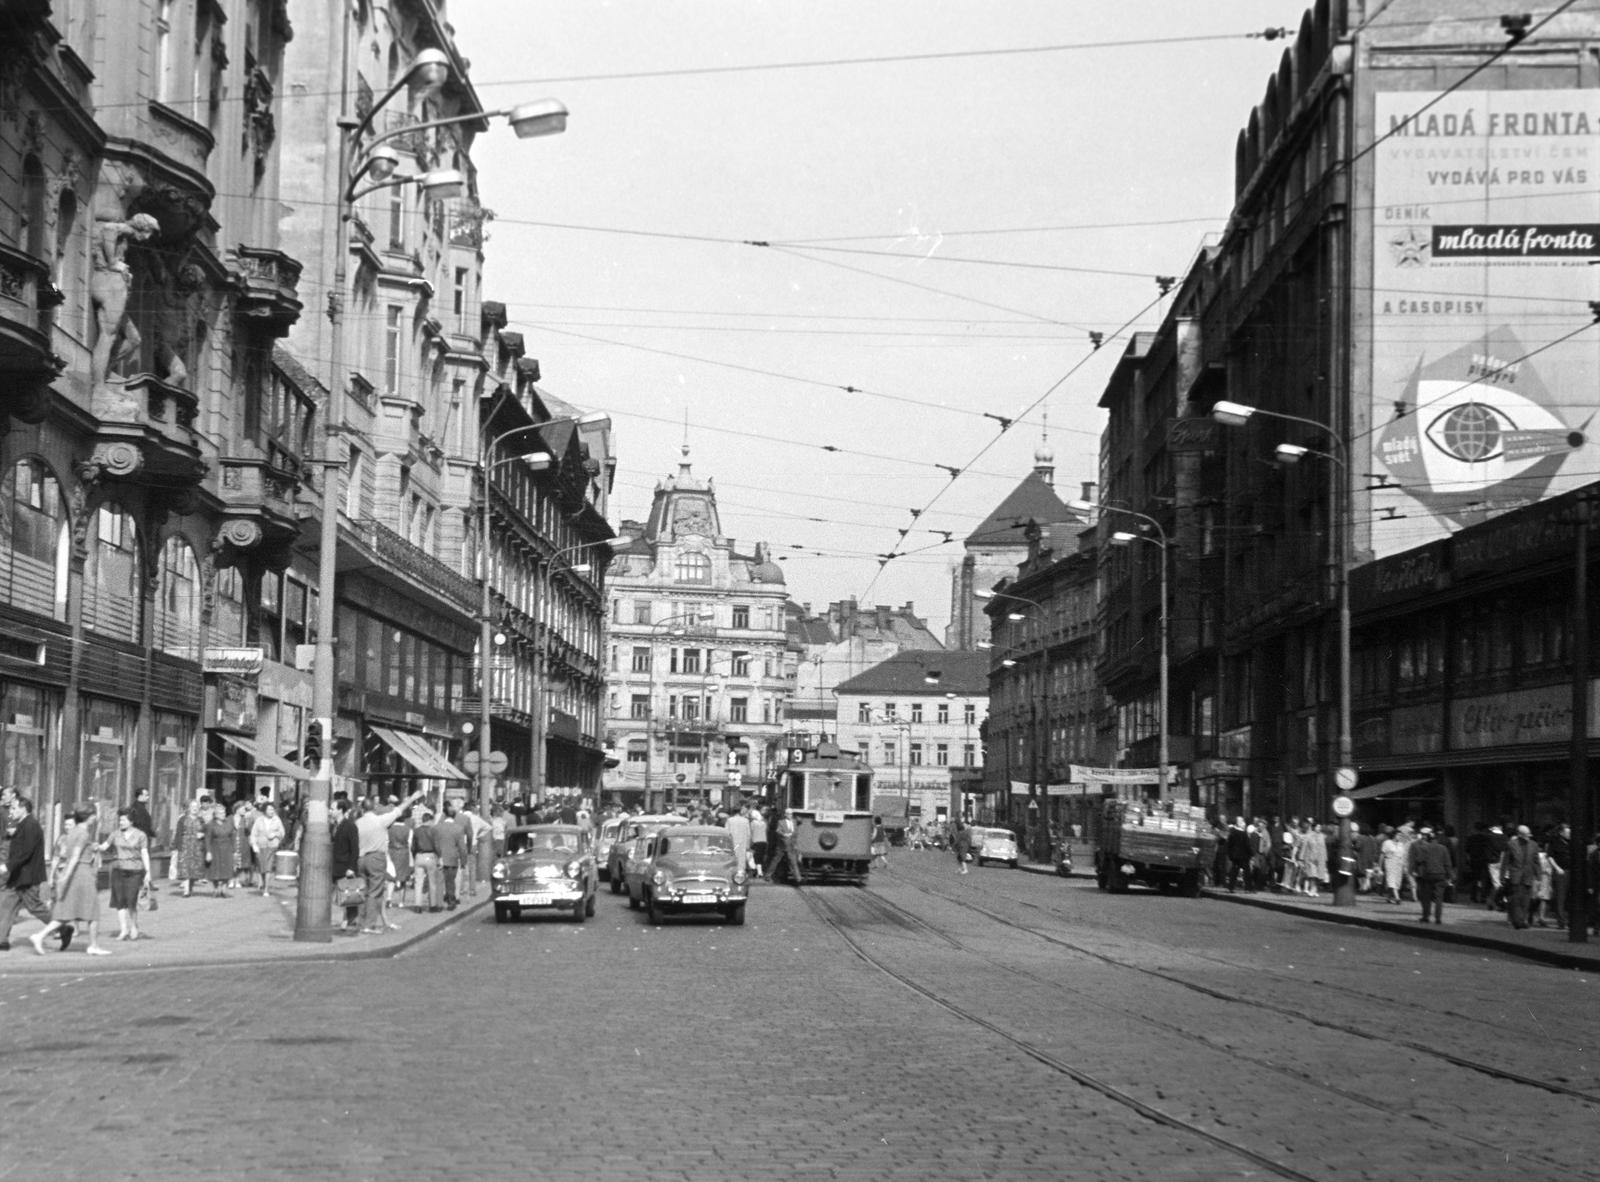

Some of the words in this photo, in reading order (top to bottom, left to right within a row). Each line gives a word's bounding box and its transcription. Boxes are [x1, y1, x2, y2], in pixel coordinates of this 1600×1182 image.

[1389, 108, 1476, 137] MLADÁ
[1489, 112, 1591, 136] FRONTA
[1427, 166, 1500, 185] VYDÁVÁ
[1507, 170, 1545, 185] PRO
[1552, 166, 1588, 184] VÁS
[1385, 204, 1431, 220] DENÍK
[1438, 228, 1521, 250] mladá
[1522, 227, 1597, 255] fronta
[1383, 301, 1391, 313] A
[1399, 296, 1485, 313] ČASOPISY
[793, 749, 803, 763] 9
